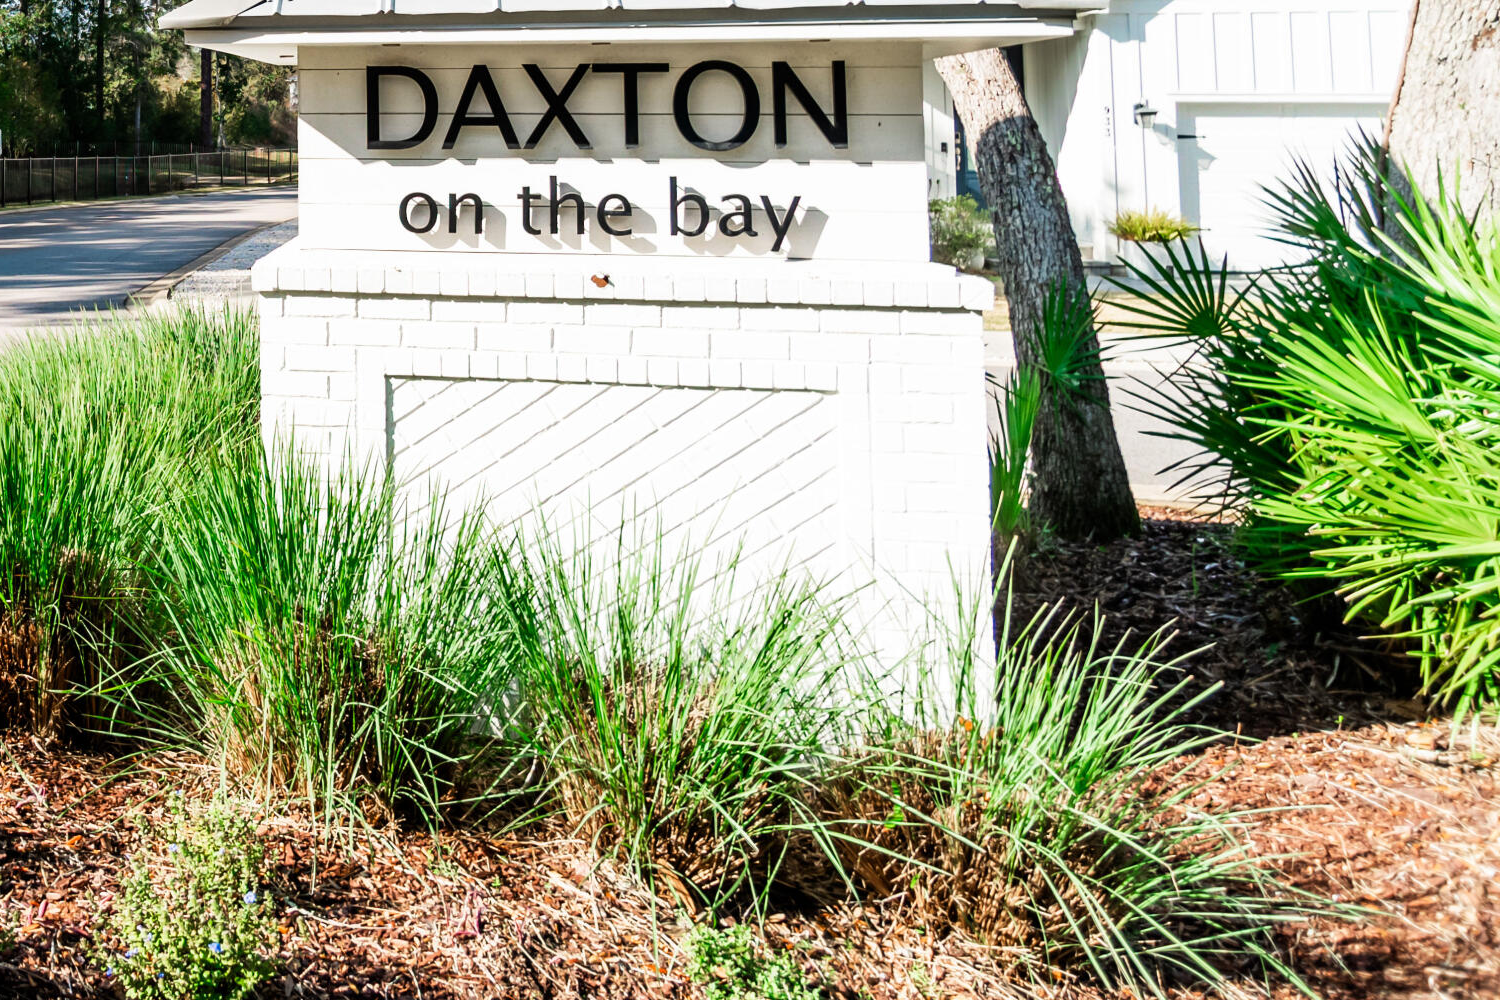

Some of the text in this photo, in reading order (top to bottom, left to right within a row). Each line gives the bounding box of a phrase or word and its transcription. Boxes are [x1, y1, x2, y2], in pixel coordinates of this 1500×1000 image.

[366, 60, 848, 150] DAXTON
[399, 176, 802, 252] on the bay
